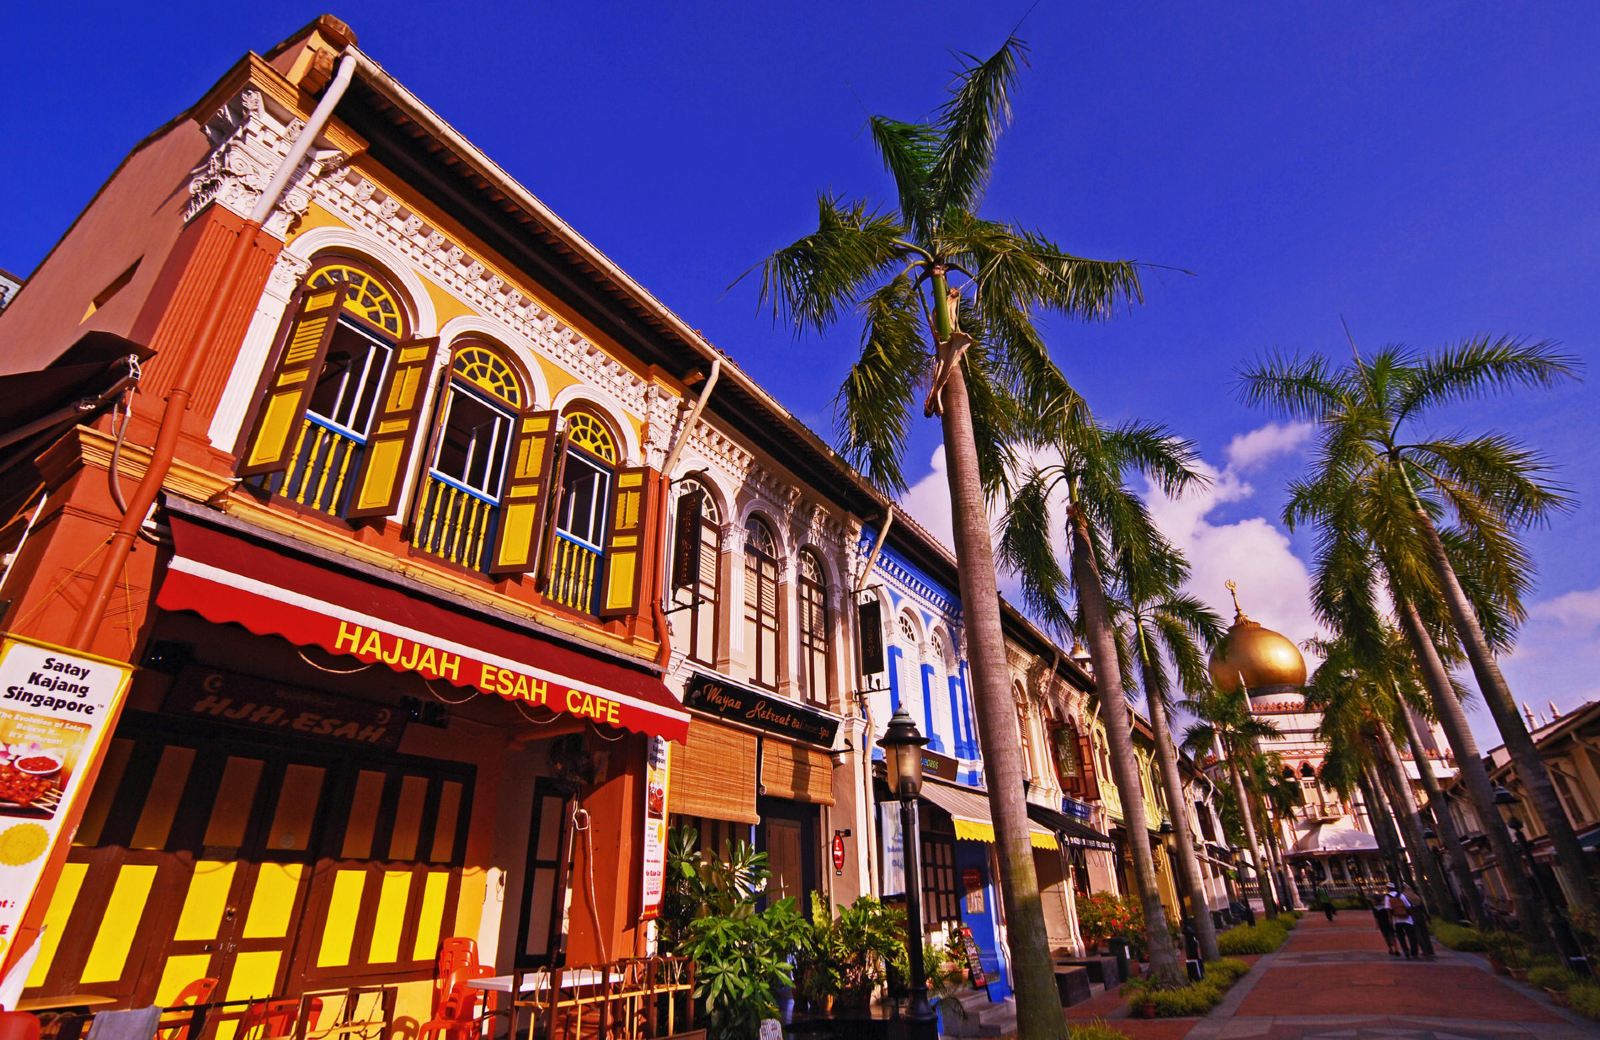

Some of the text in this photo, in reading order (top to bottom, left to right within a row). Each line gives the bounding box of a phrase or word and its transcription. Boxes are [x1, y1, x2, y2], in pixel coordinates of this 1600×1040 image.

[42, 657, 91, 680] Satay
[335, 621, 620, 724] HAJJAH ESAH CAFE
[27, 672, 90, 698] Kajang
[3, 686, 95, 715] Singapore
[703, 684, 742, 712] Wayan
[745, 701, 791, 726] Retreat
[291, 712, 388, 743] ESAH
